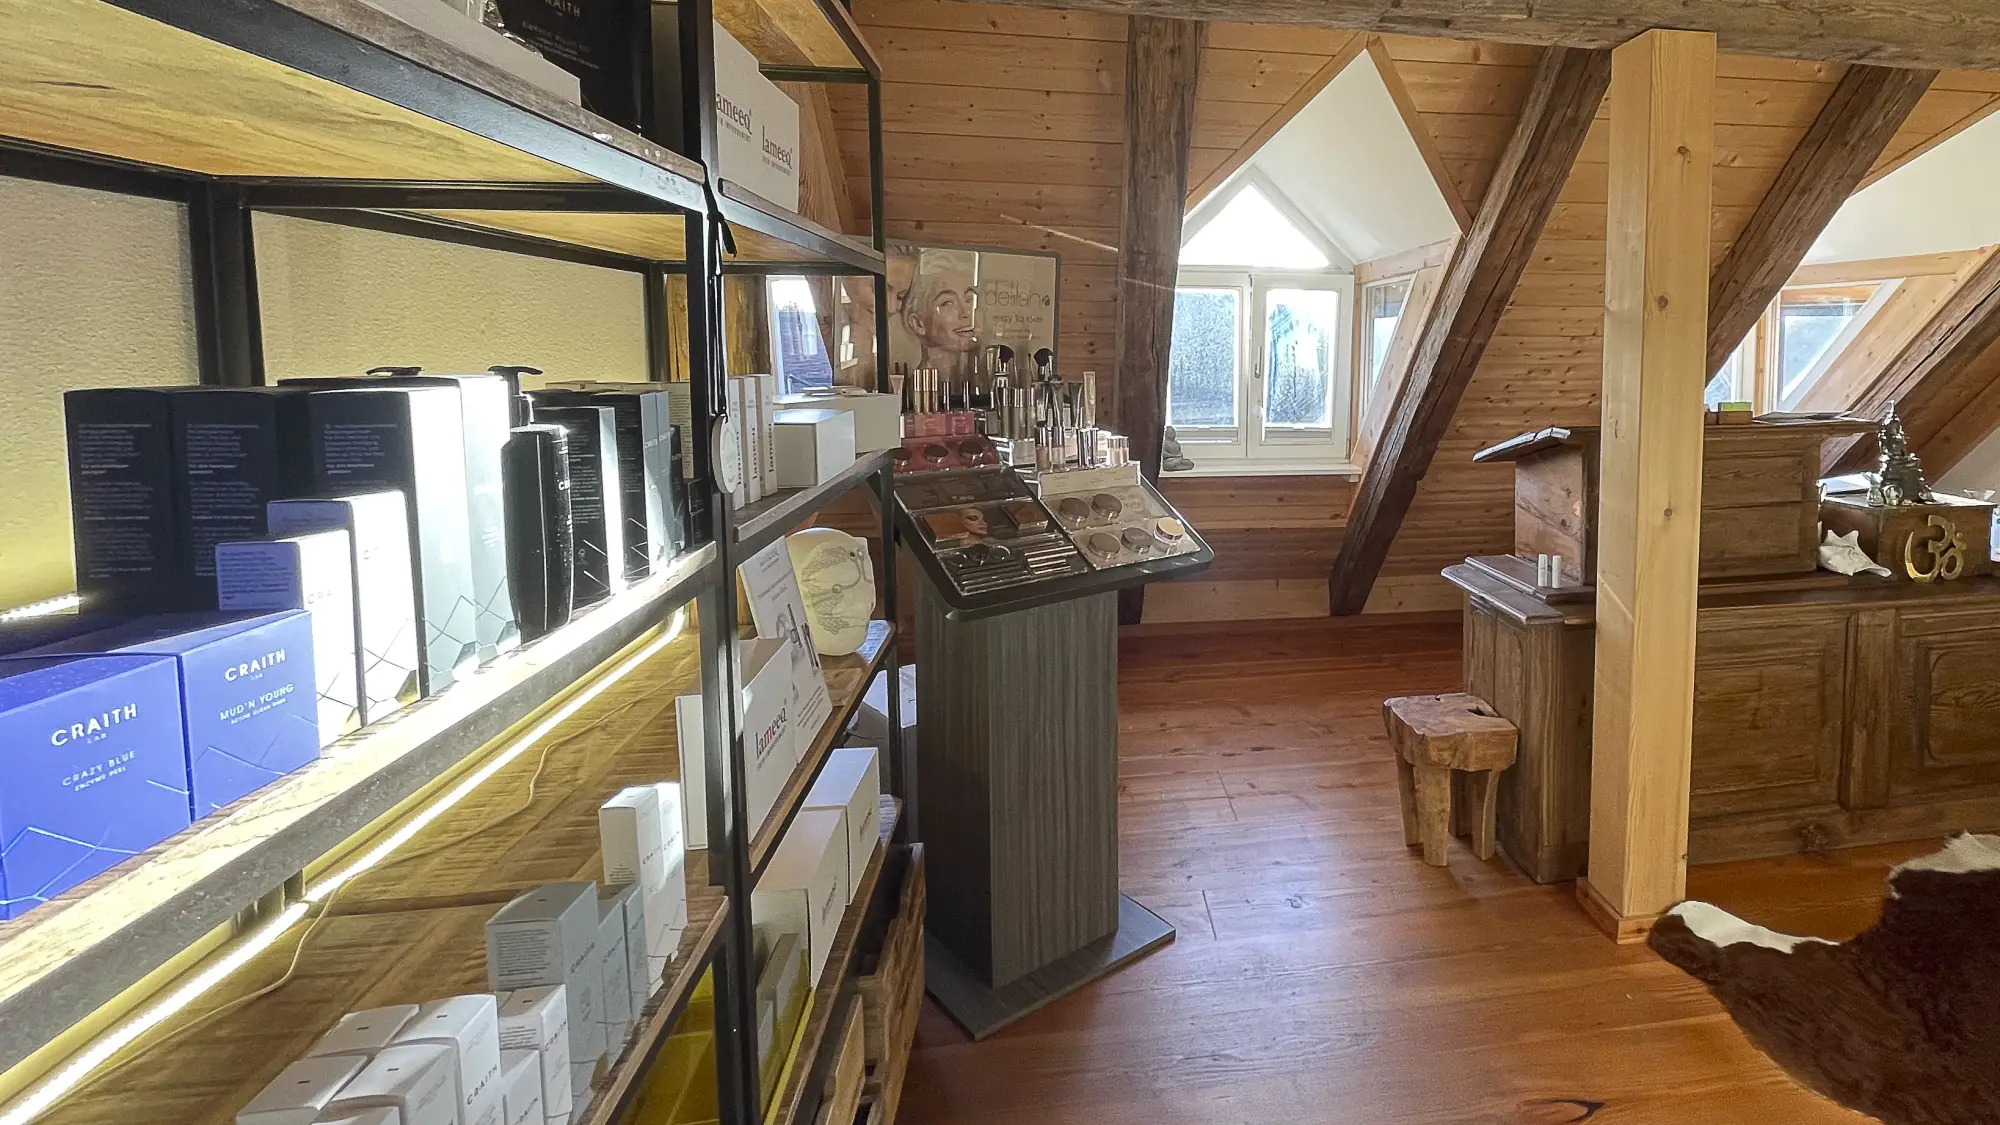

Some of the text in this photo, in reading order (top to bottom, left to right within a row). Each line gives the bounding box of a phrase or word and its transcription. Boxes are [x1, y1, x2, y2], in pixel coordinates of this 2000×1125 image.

[716, 92, 753, 135] ameeq
[224, 648, 286, 682] CRAITH
[220, 699, 256, 721] MUD'N
[259, 683, 294, 705] YOUNG
[51, 702, 138, 746] CRAITH
[62, 750, 135, 786] CRAZY BLUE
[466, 1063, 498, 1106] CRAITH
